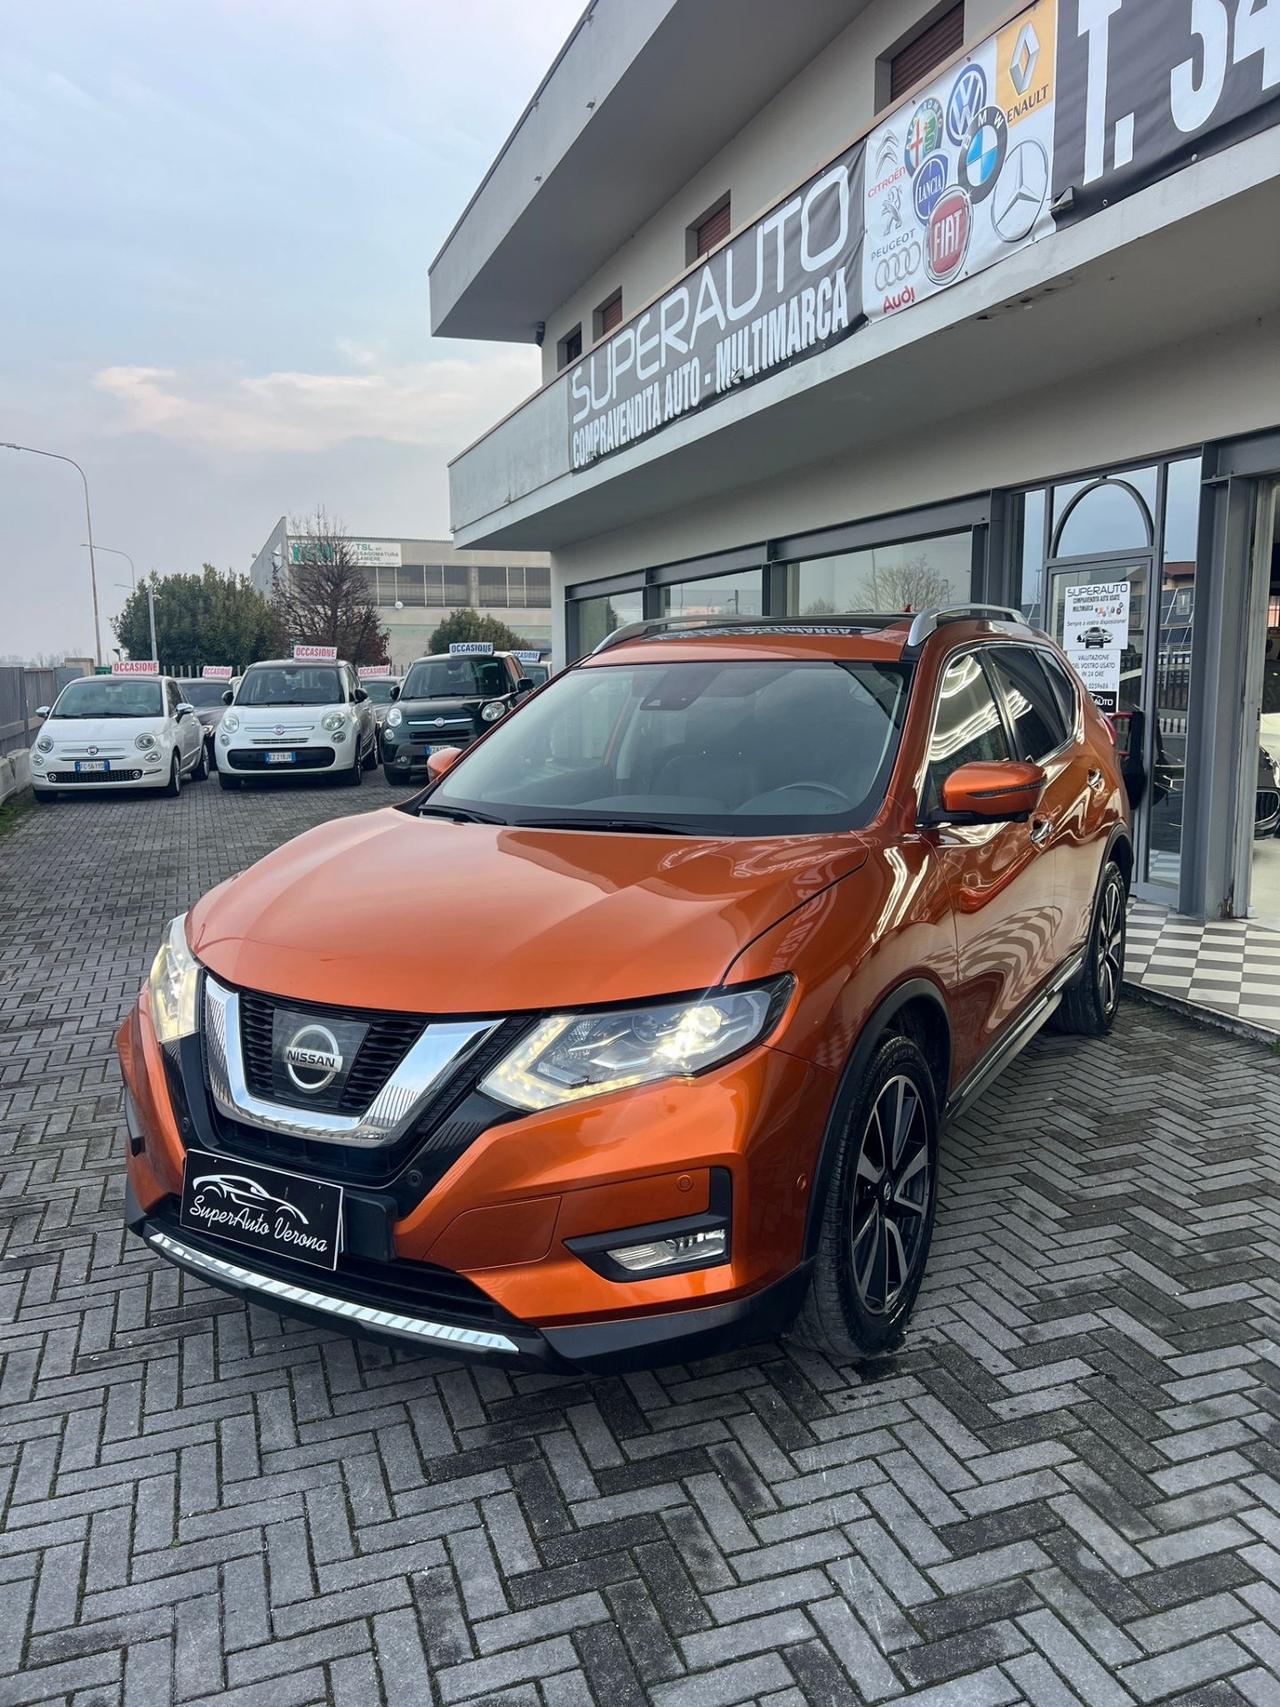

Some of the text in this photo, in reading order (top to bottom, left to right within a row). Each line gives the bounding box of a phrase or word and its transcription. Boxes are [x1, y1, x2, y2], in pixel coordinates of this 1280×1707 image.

[1007, 84, 1049, 123] ENAULT
[918, 174, 942, 203] LANCIA
[871, 228, 916, 261] PEUGEOT
[933, 208, 963, 262] FIAT
[571, 165, 849, 425] SUPERAUTO
[882, 286, 915, 314] Audi
[572, 381, 662, 469] COMPRAVENDITA
[663, 356, 700, 420] AUTO
[714, 265, 849, 394] MULTIMARCA
[1067, 583, 1128, 598] SUPERAUTO
[295, 646, 337, 658] OCCASIONE
[450, 643, 492, 653] OCCASIONE
[114, 662, 158, 672] OCCASIONE
[204, 667, 232, 677] OCCASIONE
[359, 666, 390, 676] OCCASIONE
[286, 1048, 336, 1068] NISSAN
[189, 1195, 328, 1253] SuperAuto Verona
